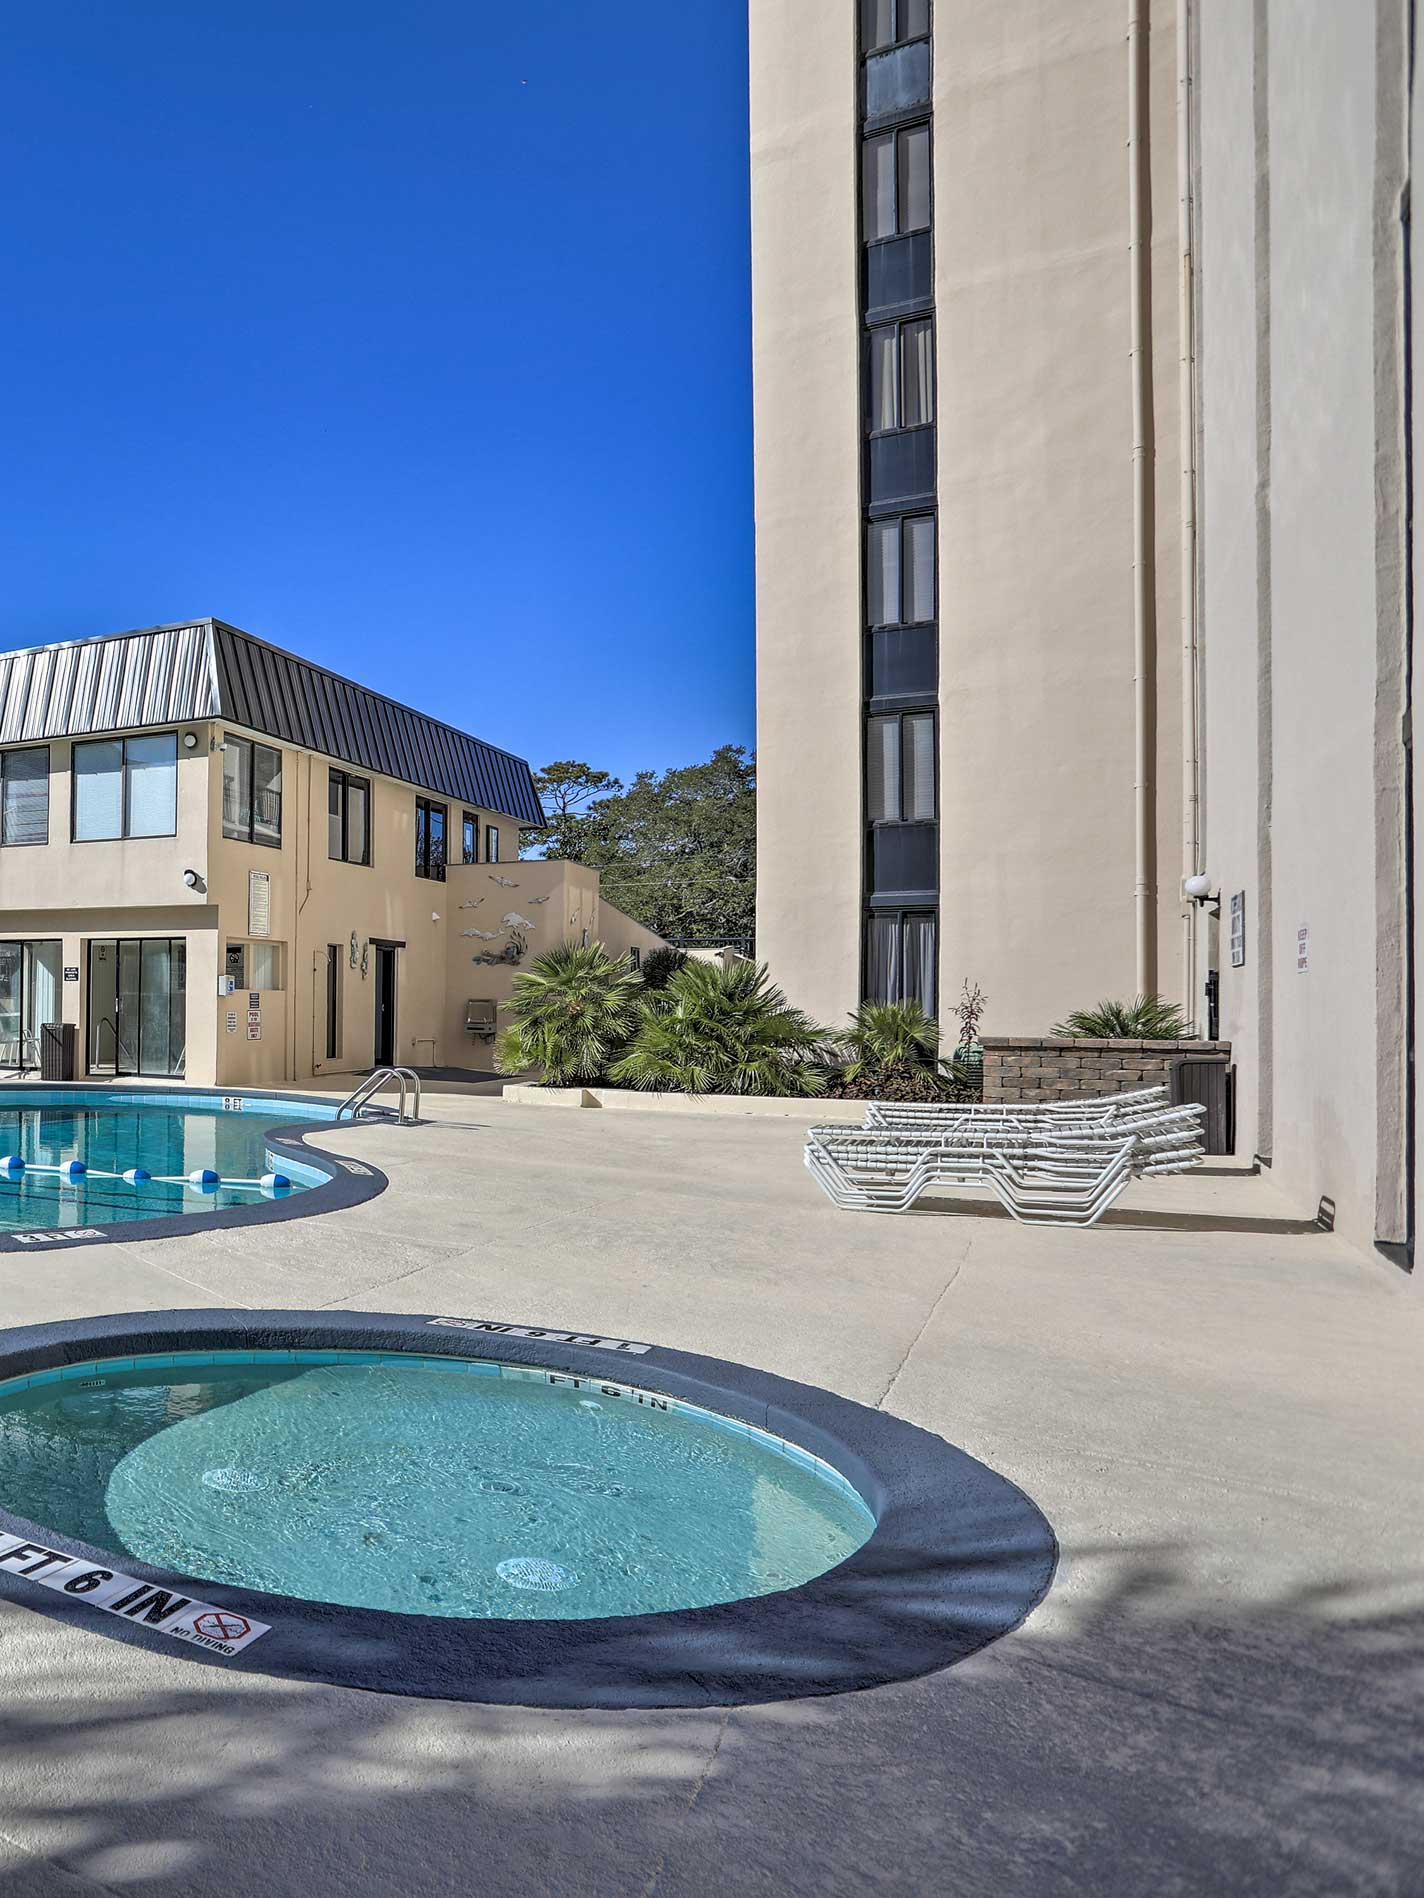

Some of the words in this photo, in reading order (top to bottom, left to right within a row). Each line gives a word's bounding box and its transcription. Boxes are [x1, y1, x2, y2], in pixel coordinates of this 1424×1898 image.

[549, 1375, 587, 1389] FT
[638, 1394, 668, 1412] IN
[63, 1570, 114, 1595] 6
[108, 1584, 193, 1626] IN
[170, 1626, 191, 1637] NO
[192, 1634, 235, 1654] DIVING
